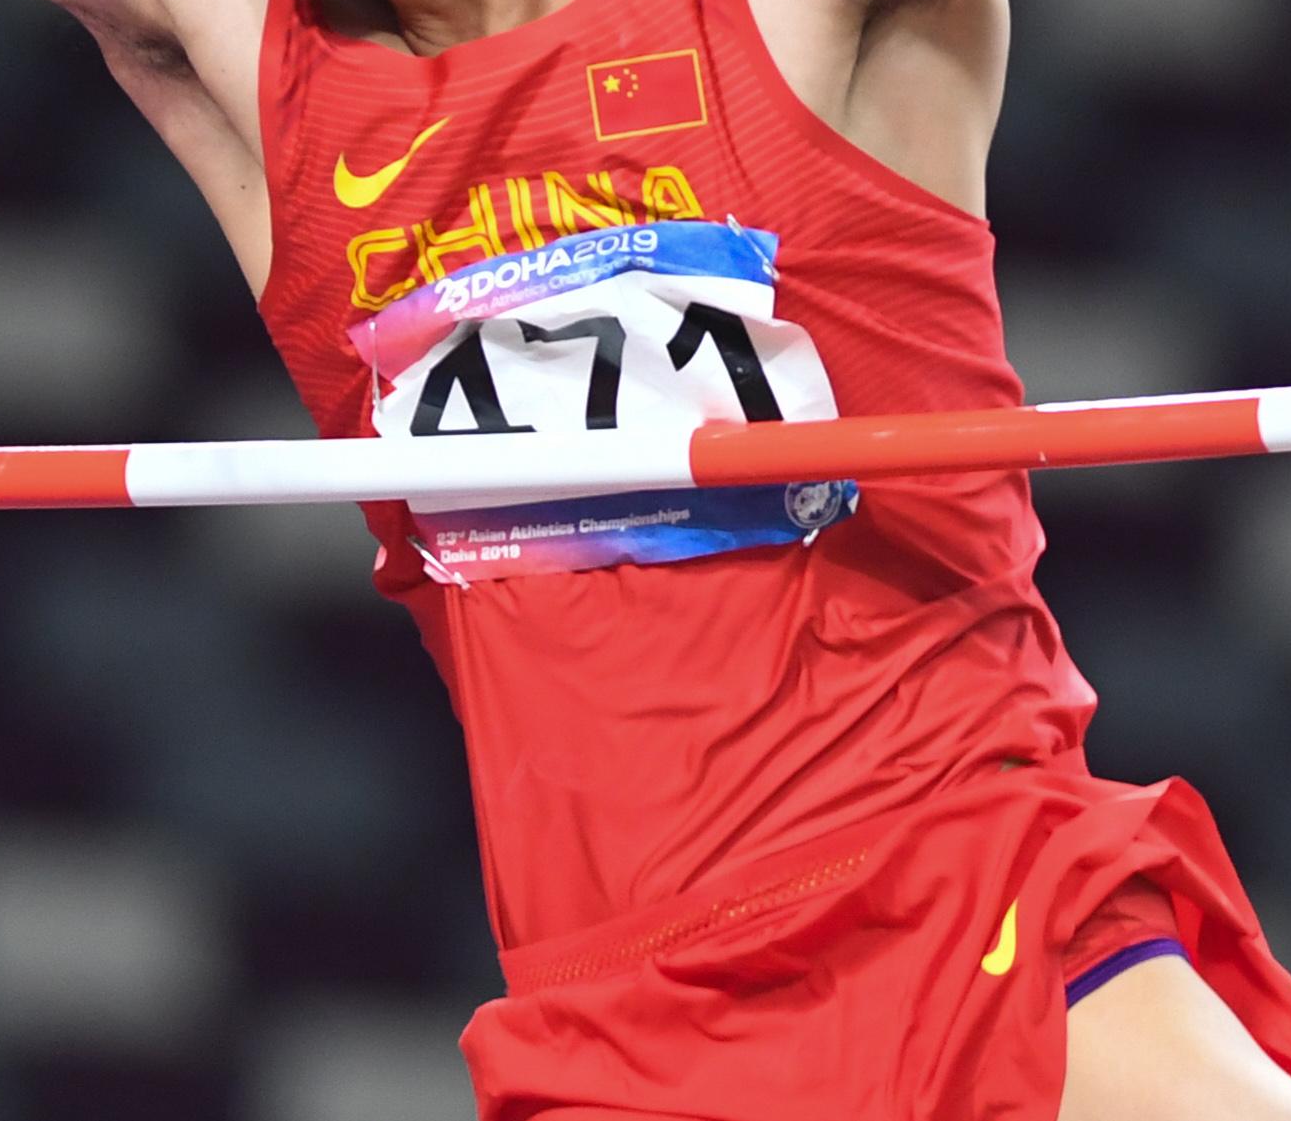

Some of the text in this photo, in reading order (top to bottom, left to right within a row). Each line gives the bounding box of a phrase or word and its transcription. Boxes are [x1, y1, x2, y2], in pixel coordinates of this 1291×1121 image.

[346, 166, 704, 311] CHINA
[410, 302, 784, 437] 471
[440, 544, 521, 564] Doha 2019
[468, 528, 507, 544] Asian
[509, 522, 576, 541] Athletics
[579, 508, 691, 534] Championships
